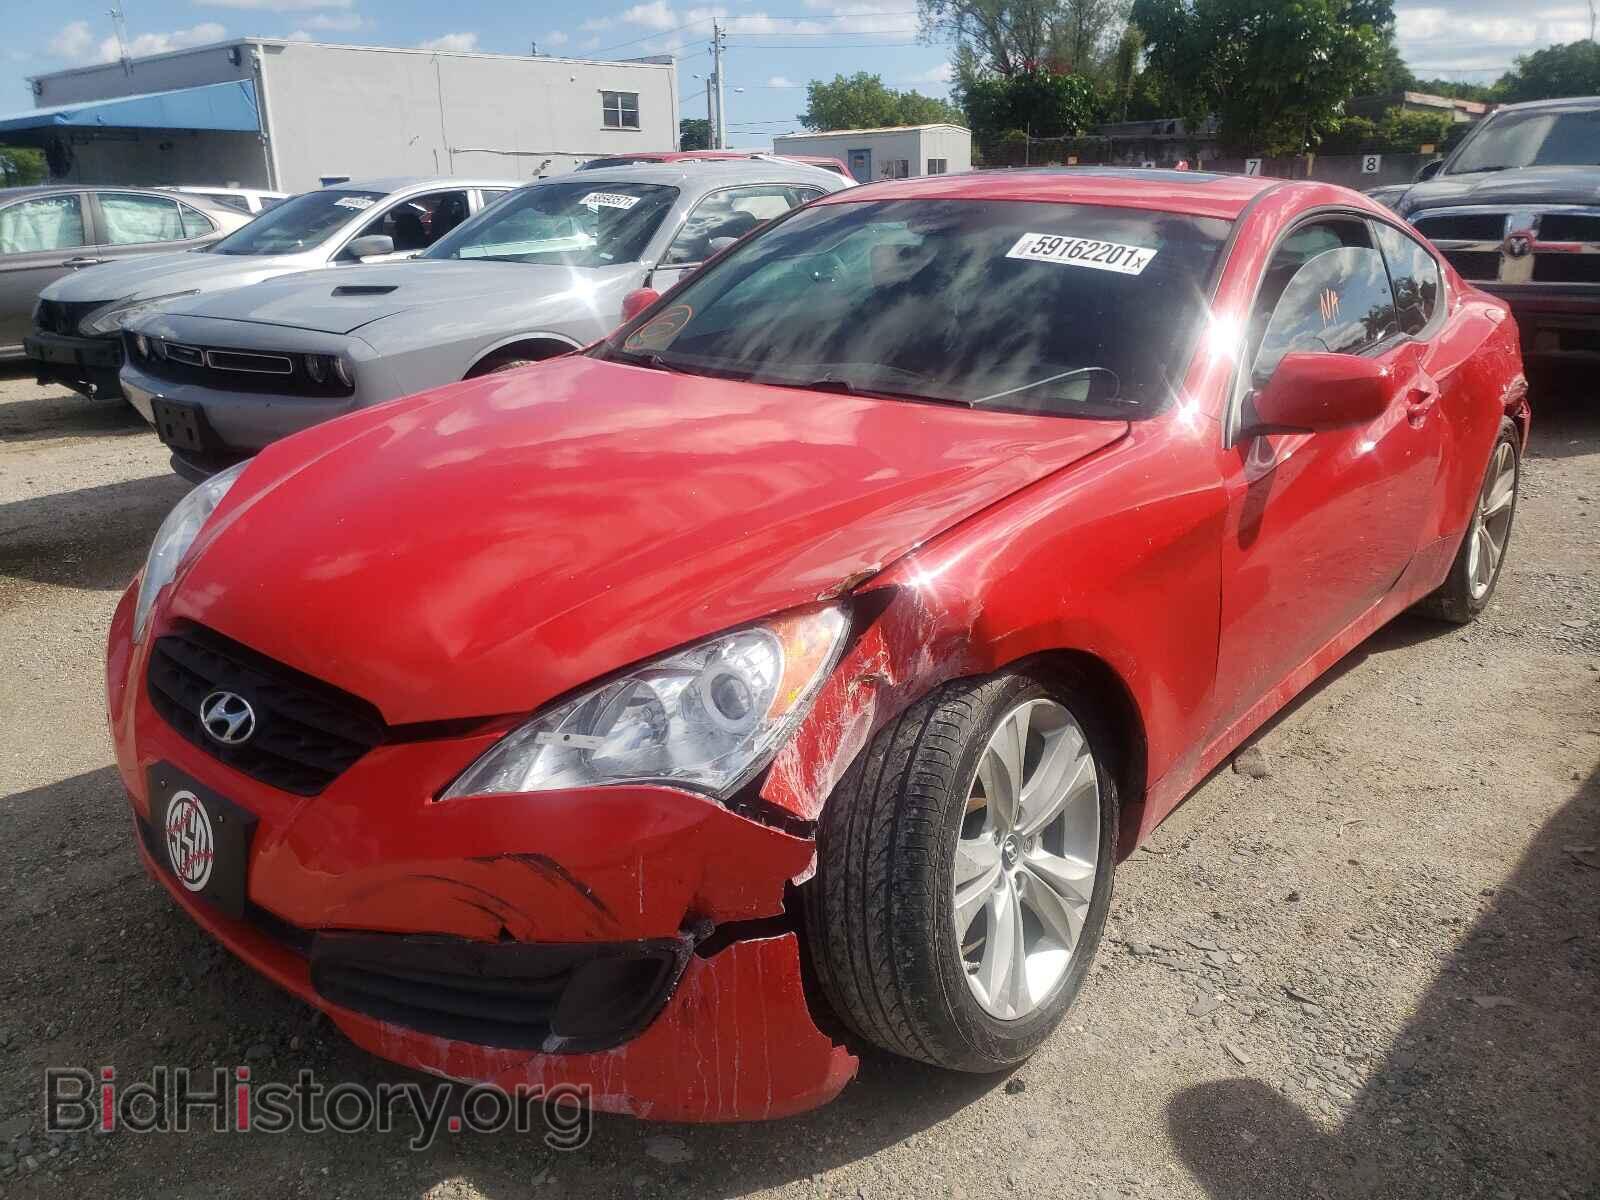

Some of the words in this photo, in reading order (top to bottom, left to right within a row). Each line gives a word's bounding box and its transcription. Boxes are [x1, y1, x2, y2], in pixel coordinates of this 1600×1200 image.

[1248, 160, 1257, 175] 7
[1366, 157, 1376, 171] 8
[1030, 236, 1139, 266] 59162201
